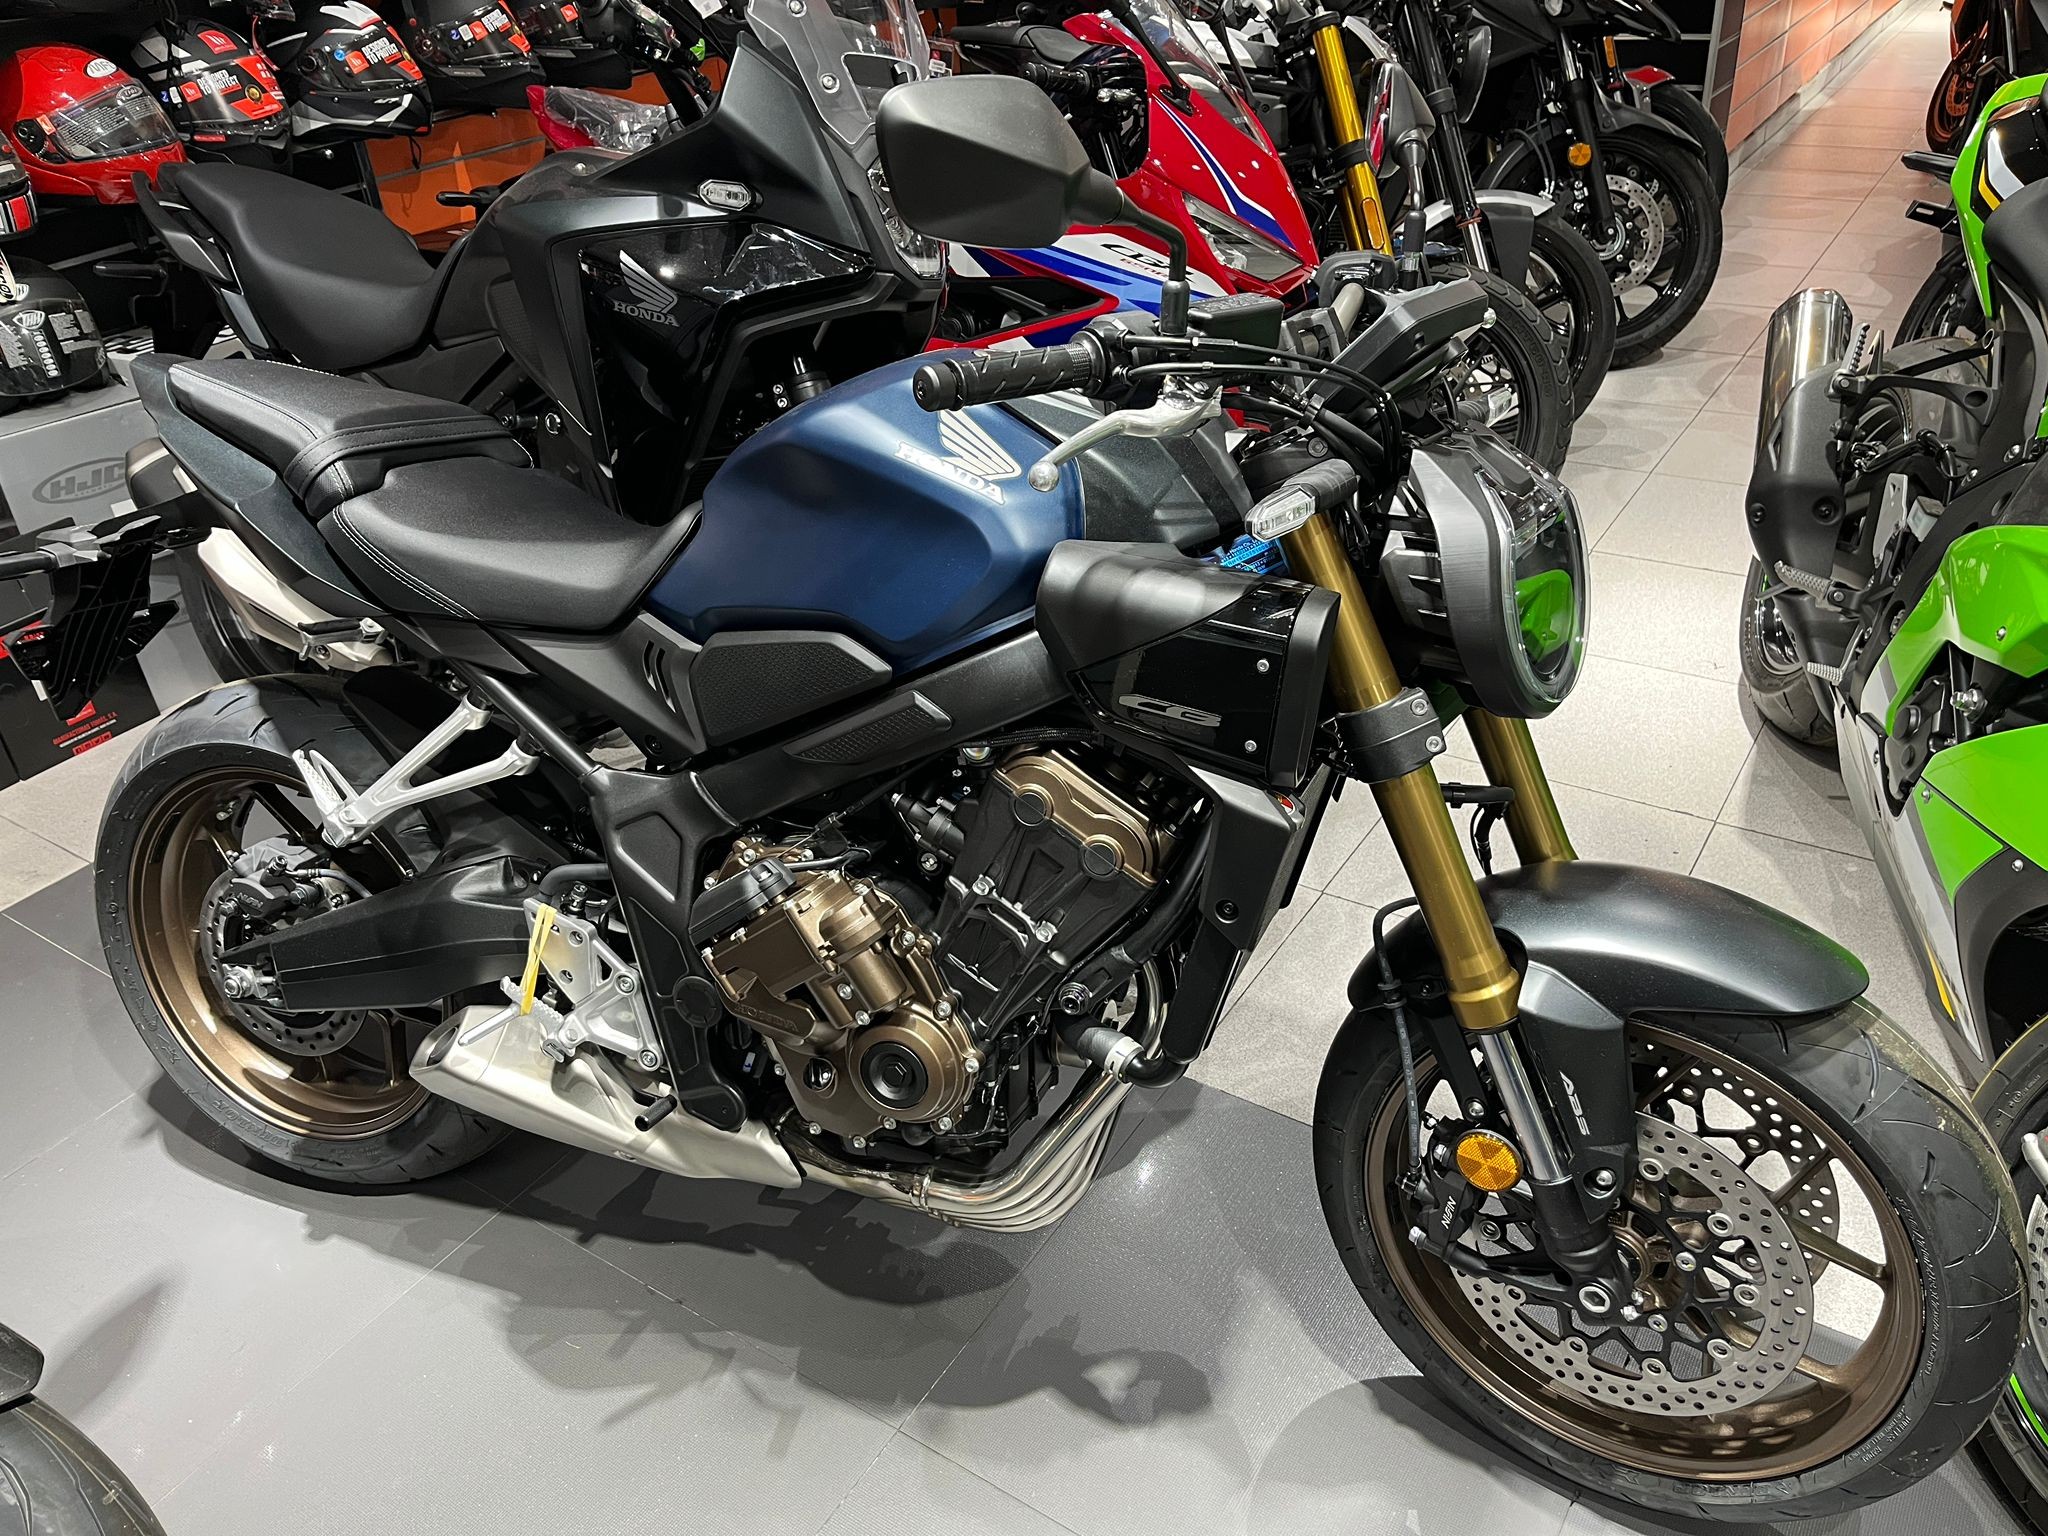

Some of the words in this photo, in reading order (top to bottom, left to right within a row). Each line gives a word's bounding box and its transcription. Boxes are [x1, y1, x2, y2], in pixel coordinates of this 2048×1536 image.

[361, 37, 390, 58] DESIGNED
[367, 52, 379, 65] TO
[374, 43, 399, 61] PROTECT
[197, 69, 230, 87] DEGNED
[201, 85, 212, 96] TO
[212, 75, 240, 92] ROTECT
[613, 300, 680, 327] HONDA
[50, 462, 126, 499] HJC
[894, 440, 1006, 505] HONDA
[1119, 694, 1221, 727] CB
[1559, 1071, 1591, 1136] ABS
